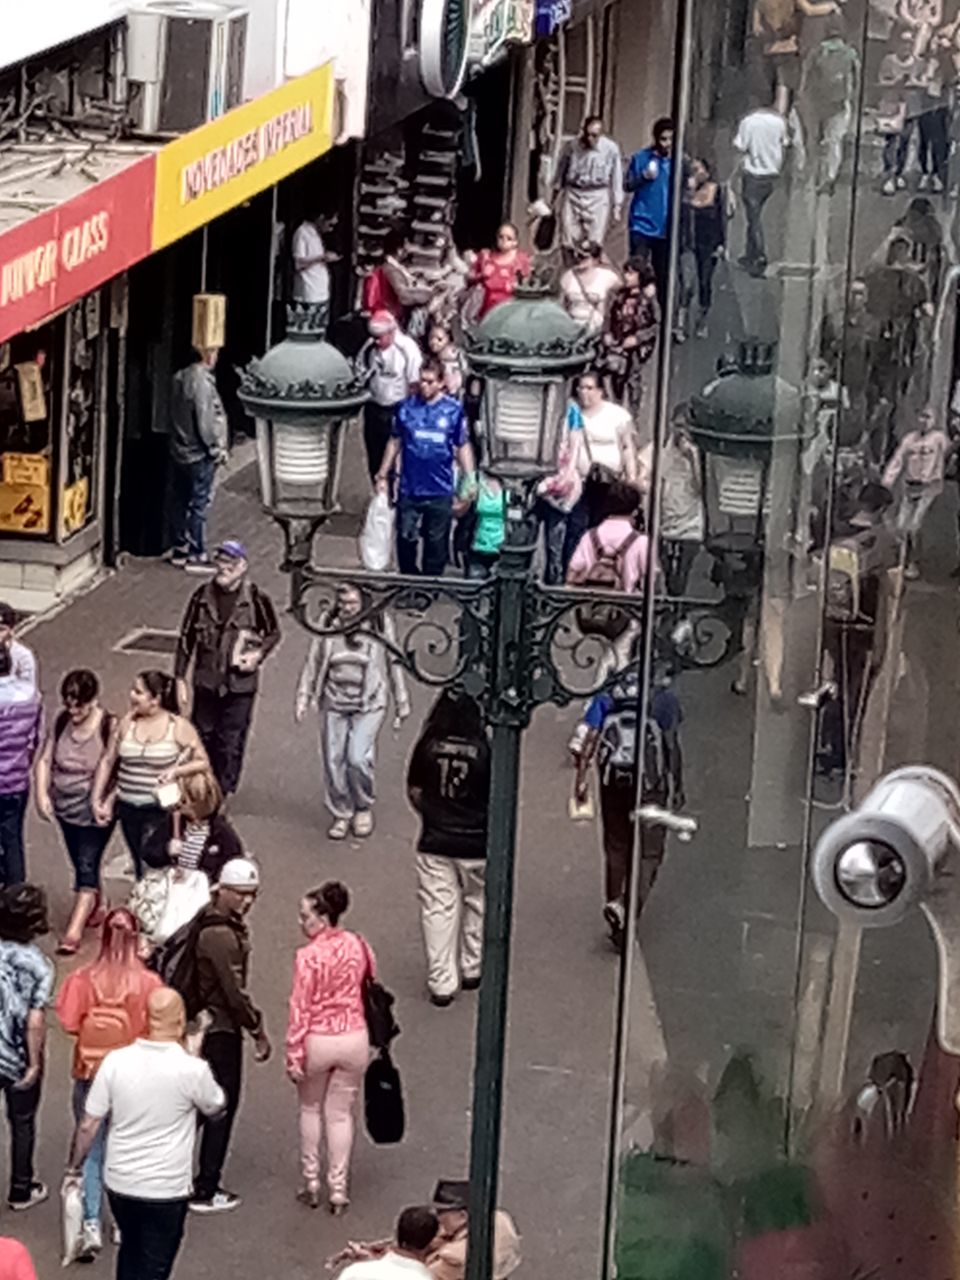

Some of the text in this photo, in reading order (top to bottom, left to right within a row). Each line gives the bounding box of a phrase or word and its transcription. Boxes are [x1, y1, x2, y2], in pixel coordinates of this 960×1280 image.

[179, 127, 259, 206] NOVEDADES
[0, 211, 110, 308] JUNIOR CLASS
